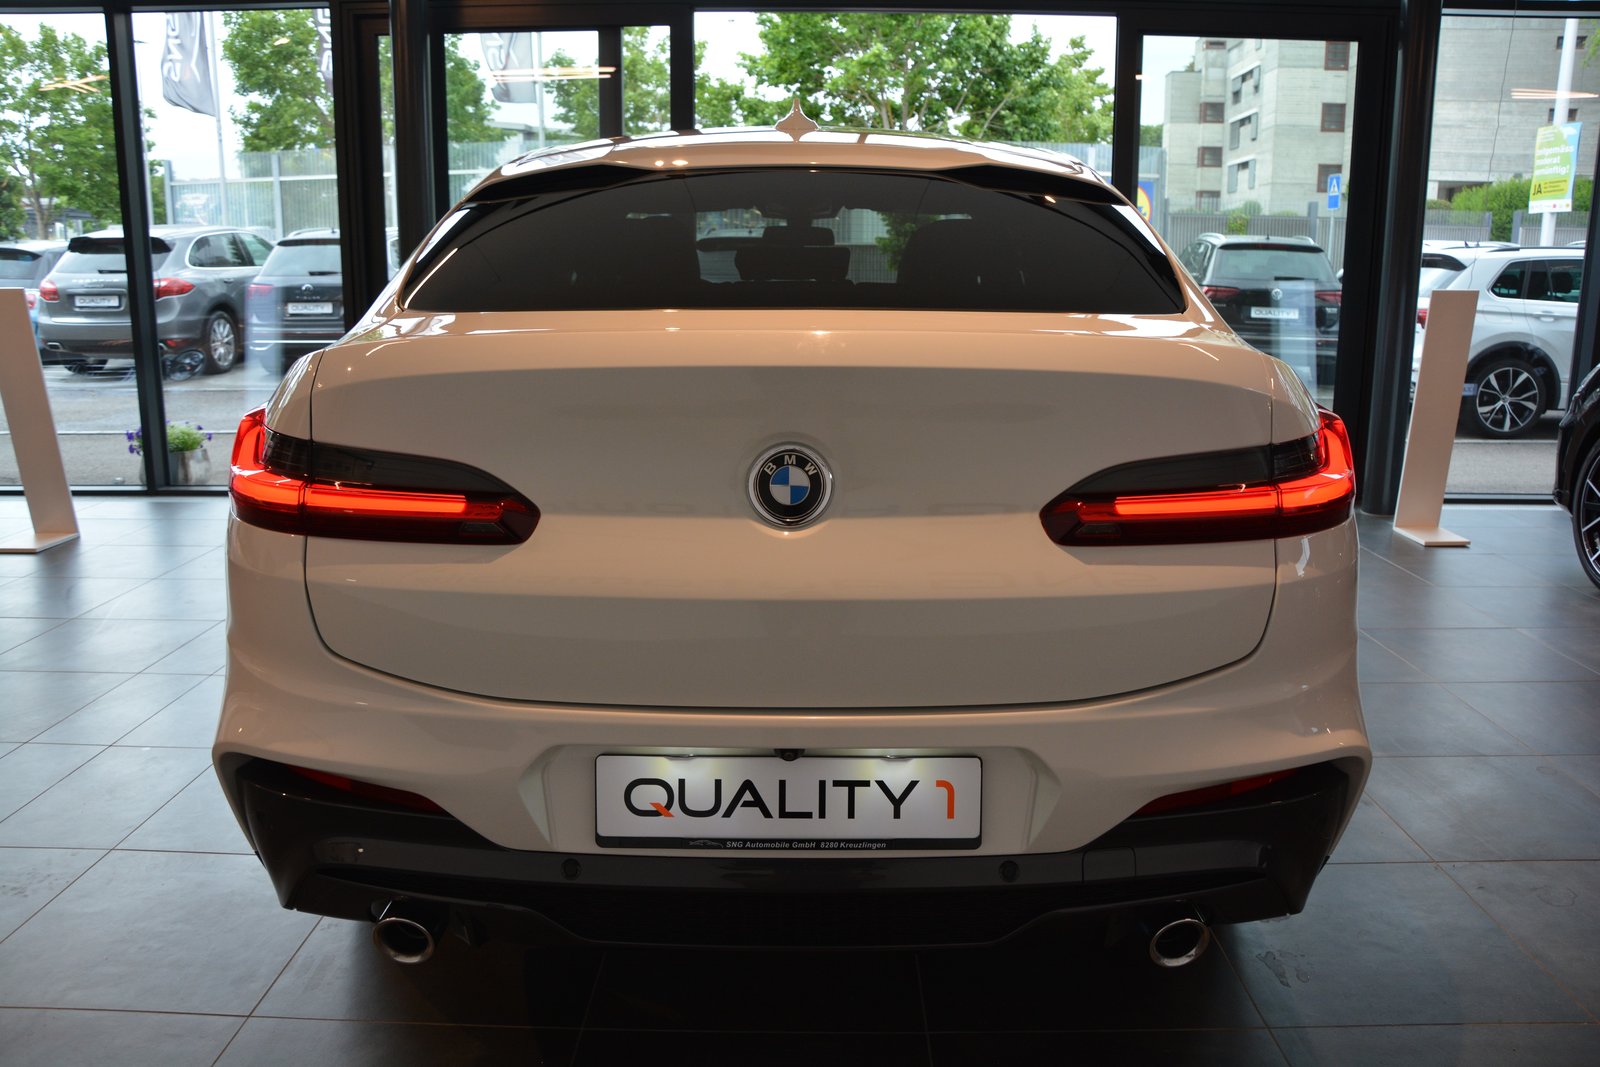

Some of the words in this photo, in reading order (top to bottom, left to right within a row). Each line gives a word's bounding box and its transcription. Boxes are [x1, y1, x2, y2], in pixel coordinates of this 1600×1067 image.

[1532, 183, 1543, 196] JA
[764, 454, 817, 476] BMW
[623, 777, 920, 820] QUALITY
[935, 779, 956, 820] 1
[726, 841, 743, 849] SNG
[745, 841, 790, 849] Automobile
[792, 841, 816, 849] GmbH
[820, 841, 839, 849] 8280
[840, 841, 887, 851] Kreuzlingen
